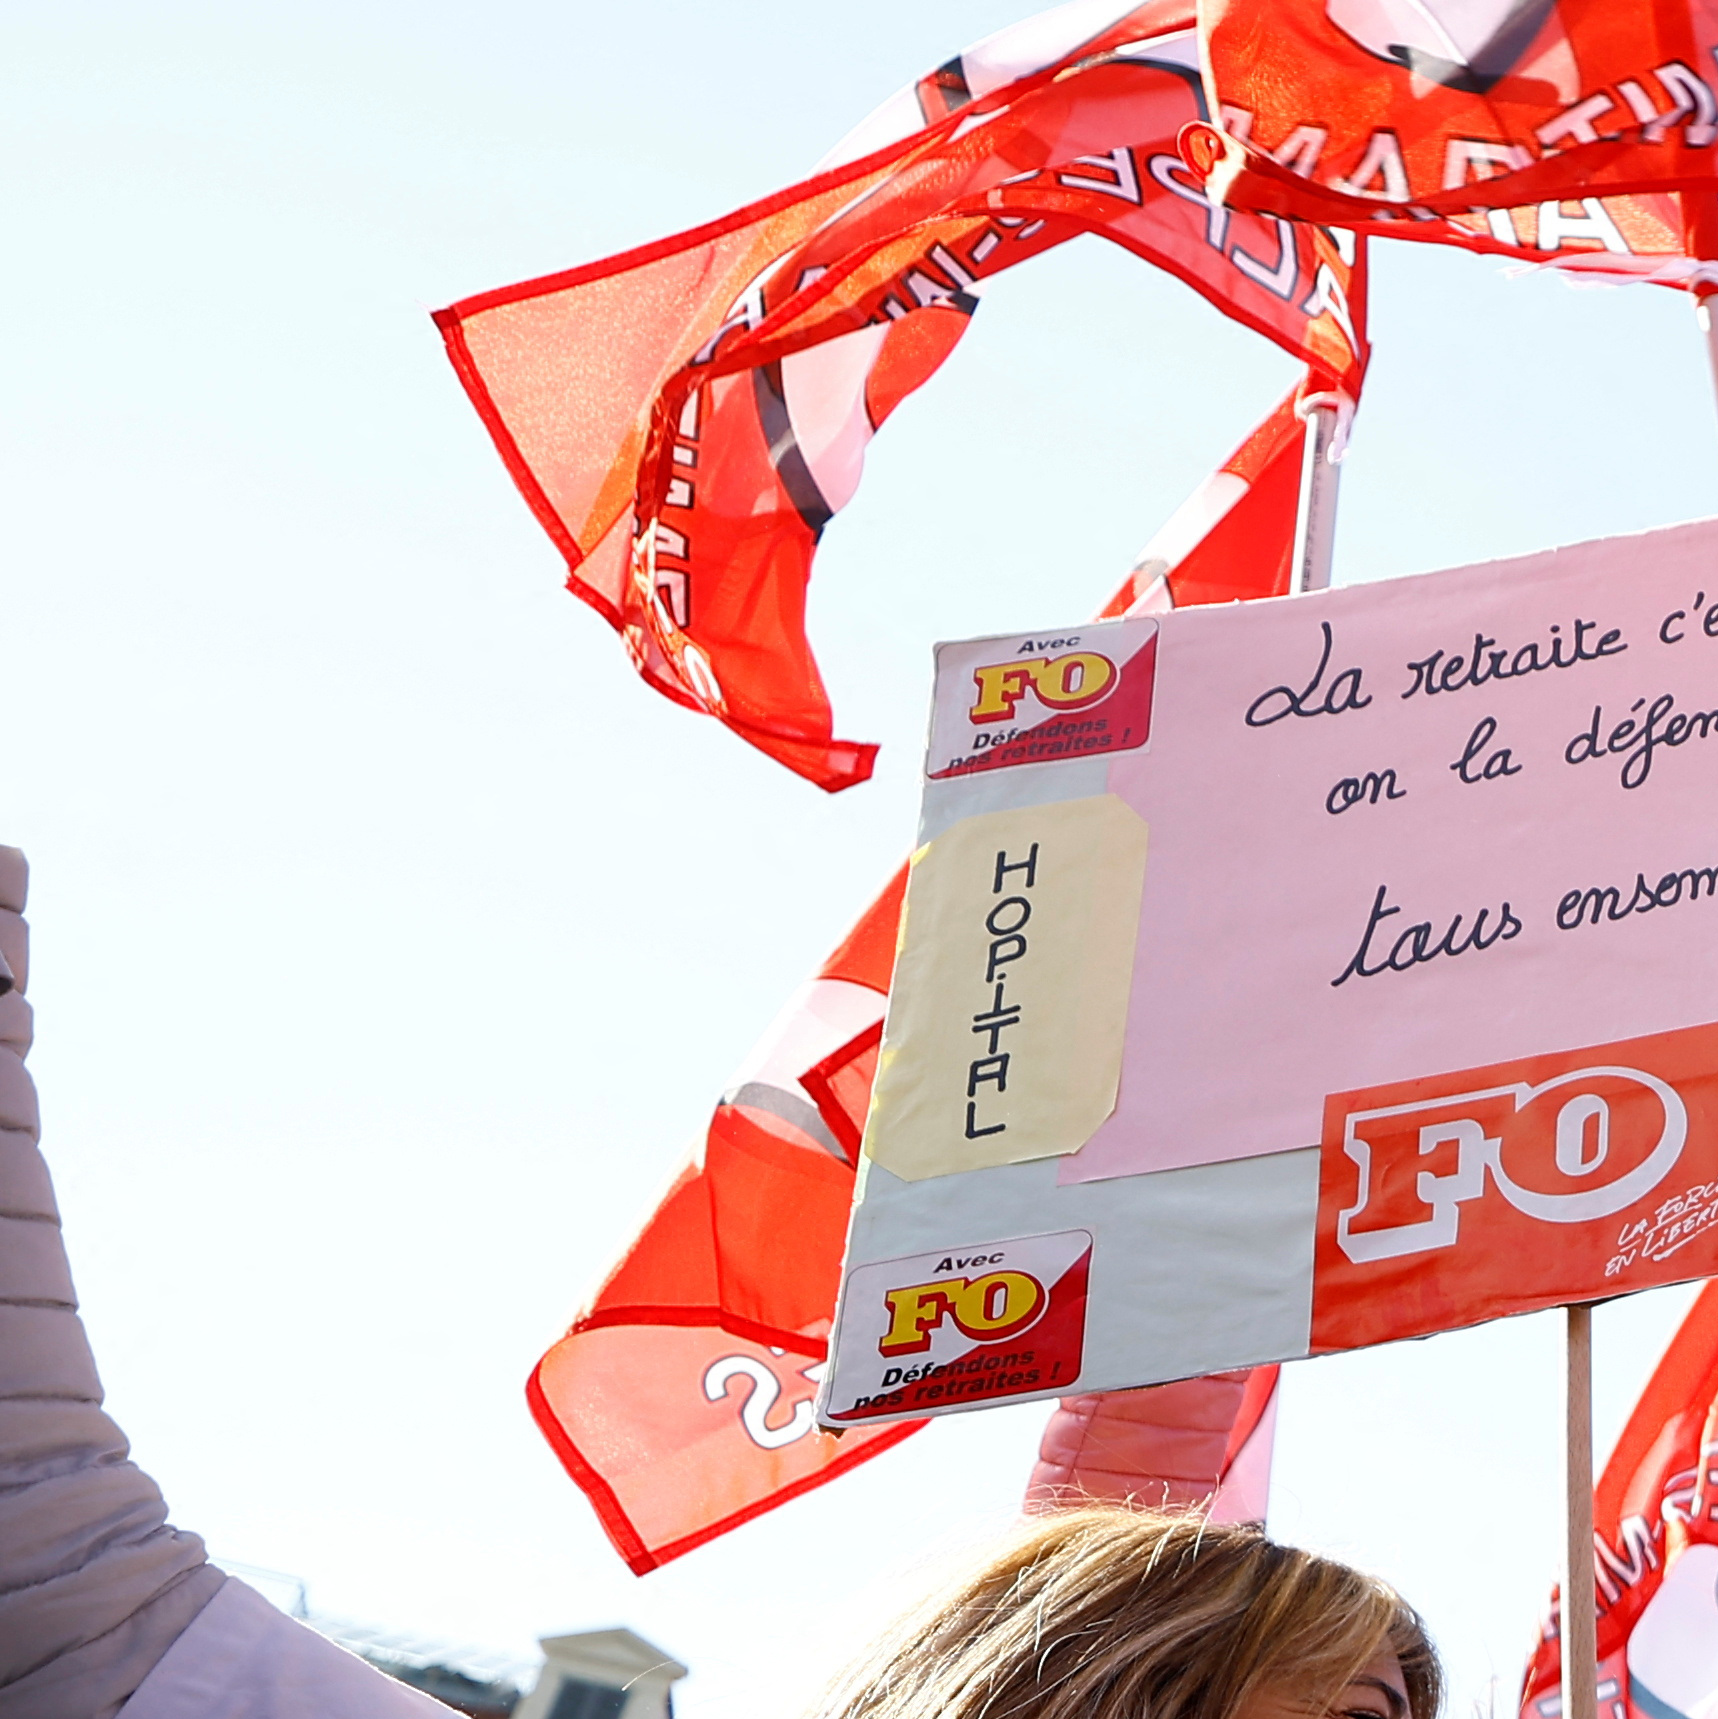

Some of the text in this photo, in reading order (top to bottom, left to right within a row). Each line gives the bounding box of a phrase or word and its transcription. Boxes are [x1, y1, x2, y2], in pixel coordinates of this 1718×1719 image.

[1018, 635, 1081, 653] Avec
[969, 650, 1119, 724] FO
[1245, 622, 1372, 726] La
[1402, 620, 1628, 699] retraite
[949, 751, 995, 770] nos
[1001, 733, 1112, 762] retraites
[972, 717, 1107, 750] Défendons
[1325, 768, 1406, 814] on
[1450, 717, 1522, 785] la
[1331, 886, 1523, 987] tous
[1337, 1066, 1687, 1263] FO
[933, 1252, 1004, 1273] Avec
[1605, 1249, 1636, 1276] EN
[878, 1270, 1045, 1358] FO
[853, 1389, 903, 1410] nos
[915, 1367, 1039, 1400] retraites
[881, 1351, 1035, 1387] Défendons
